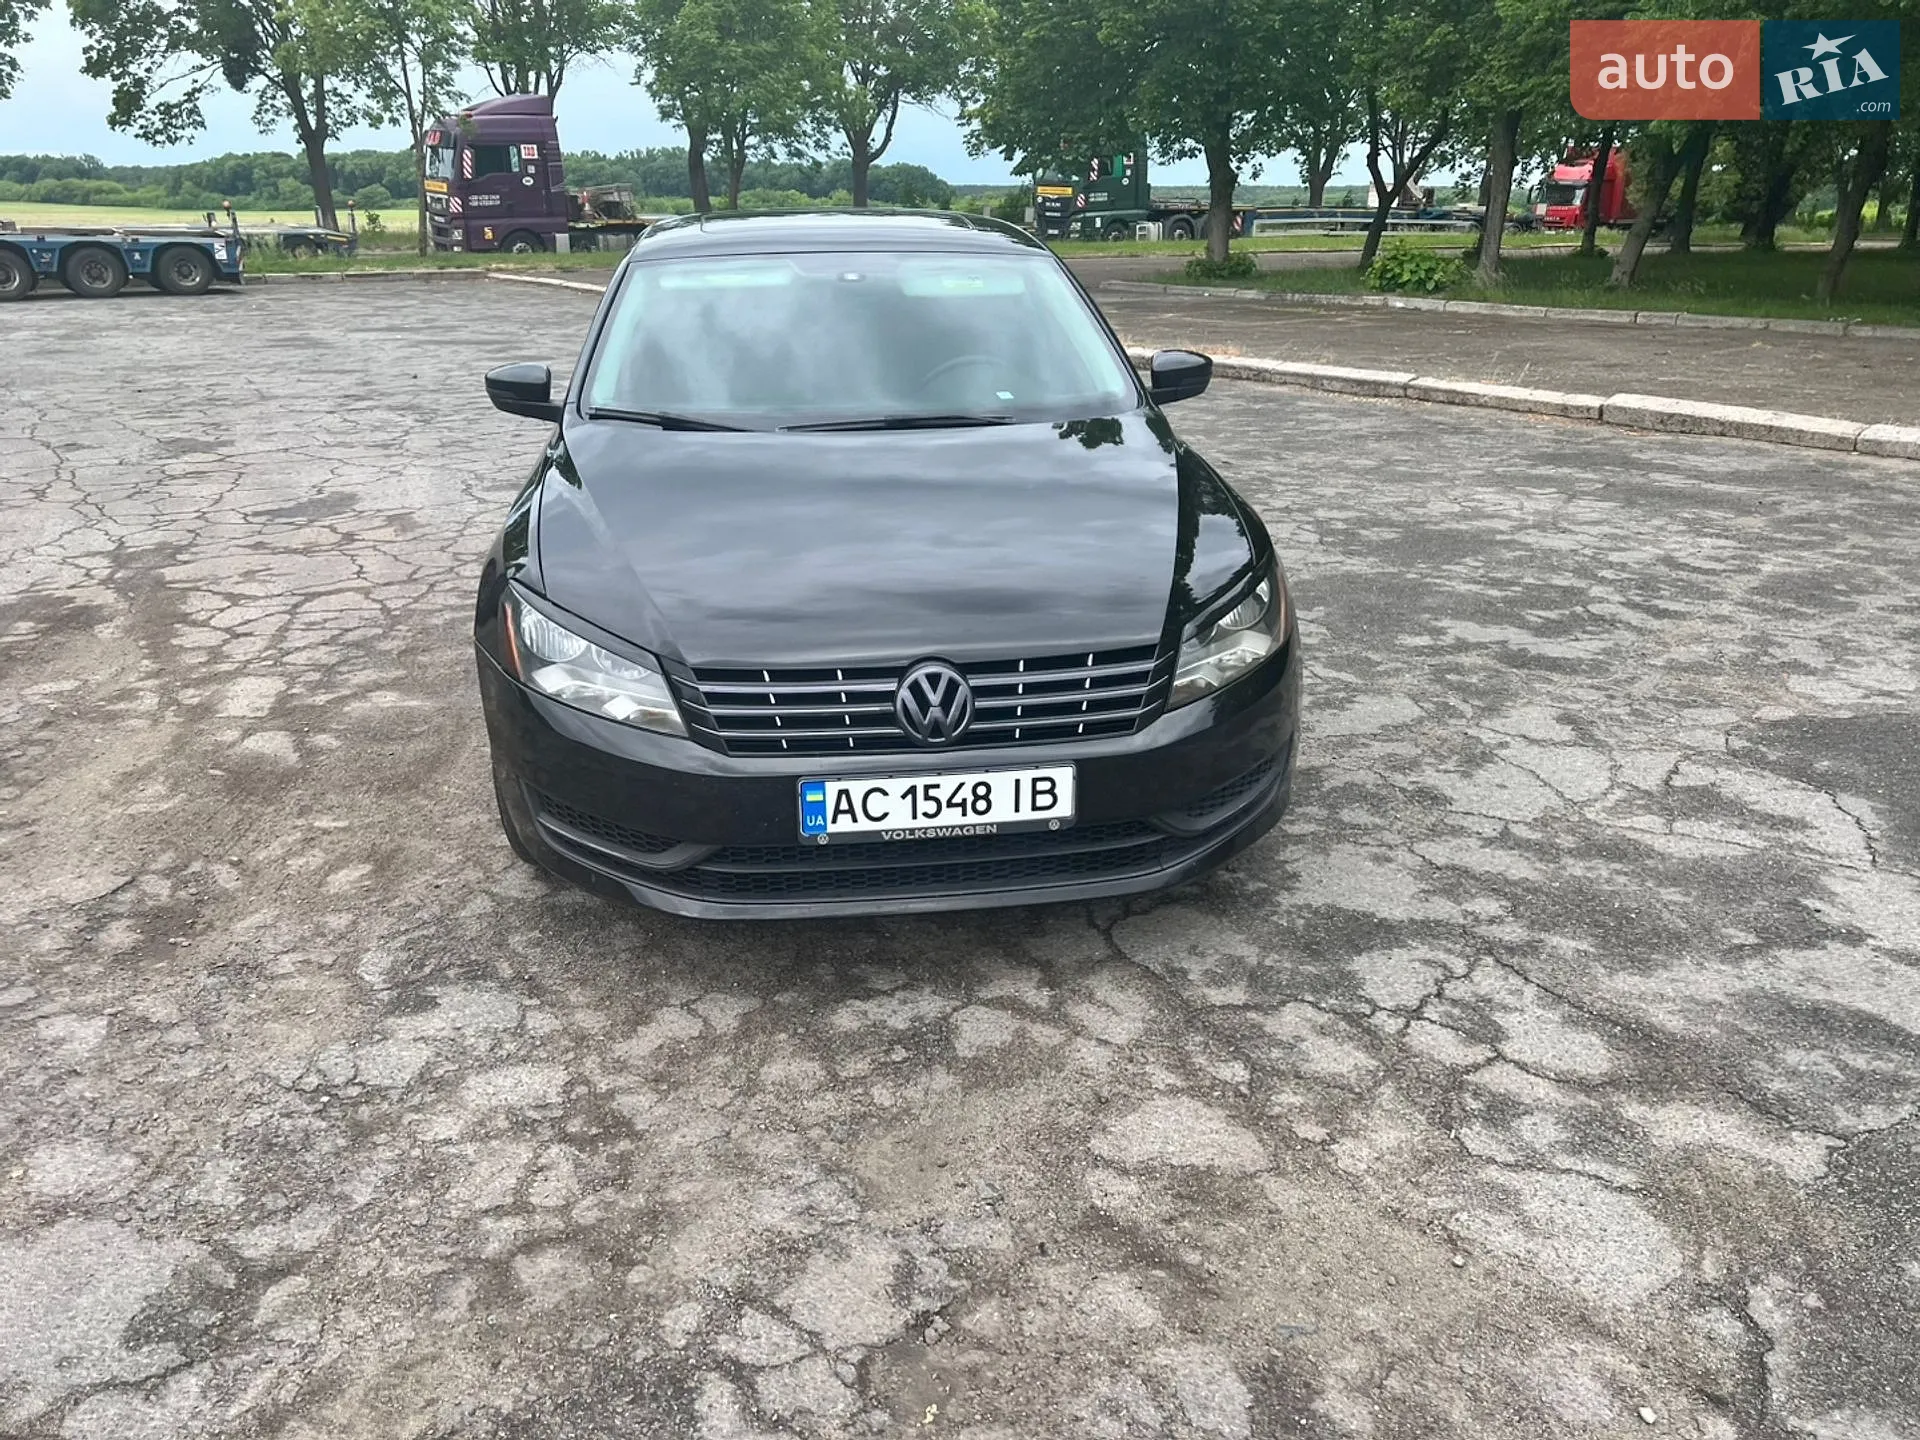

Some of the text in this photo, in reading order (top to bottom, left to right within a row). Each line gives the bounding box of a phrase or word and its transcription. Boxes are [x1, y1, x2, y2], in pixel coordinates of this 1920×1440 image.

[830, 775, 1059, 825] AC 1548 IB
[806, 815, 825, 827] UA
[881, 823, 998, 841] VOLKSWAGEN
